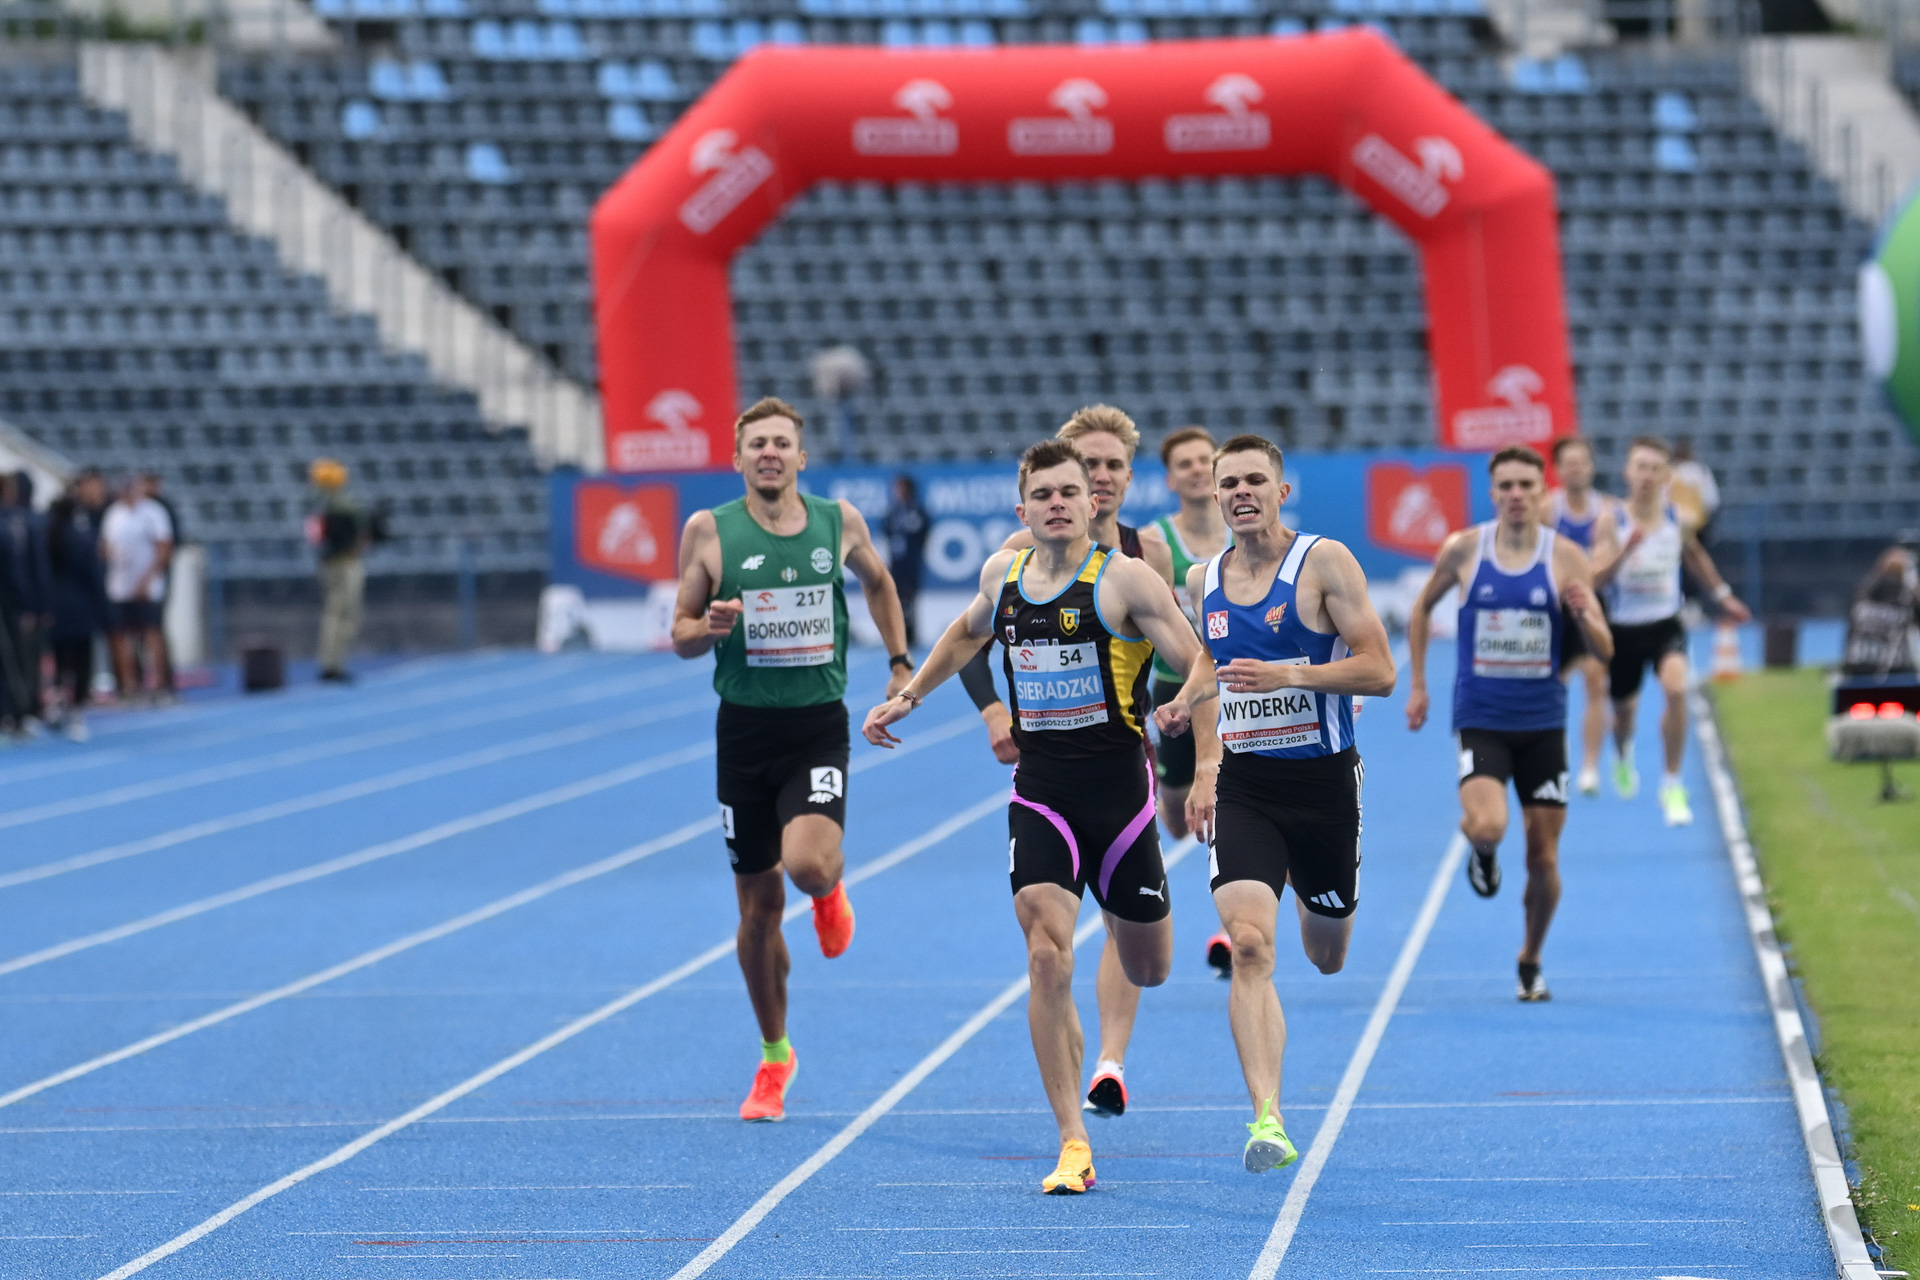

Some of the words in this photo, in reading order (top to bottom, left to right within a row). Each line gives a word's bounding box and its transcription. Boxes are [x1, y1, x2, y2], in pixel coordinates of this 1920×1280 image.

[795, 590, 826, 607] 217
[748, 617, 831, 640] BORKOWSKI
[1060, 648, 1083, 667] 54
[1016, 675, 1100, 701] SIERADZKI
[1081, 704, 1101, 714] Polski
[1223, 693, 1312, 721] WYDERKA
[1026, 719, 1073, 728] BYDGOSZCZ
[1074, 715, 1095, 725] 2025
[1236, 732, 1251, 740] PZLA
[1252, 728, 1293, 738] Mistrzostwa
[1293, 723, 1314, 733] Polski
[1232, 738, 1284, 750] BYDGOSZCZ
[1286, 734, 1308, 744] 2025
[819, 770, 837, 789] 4
